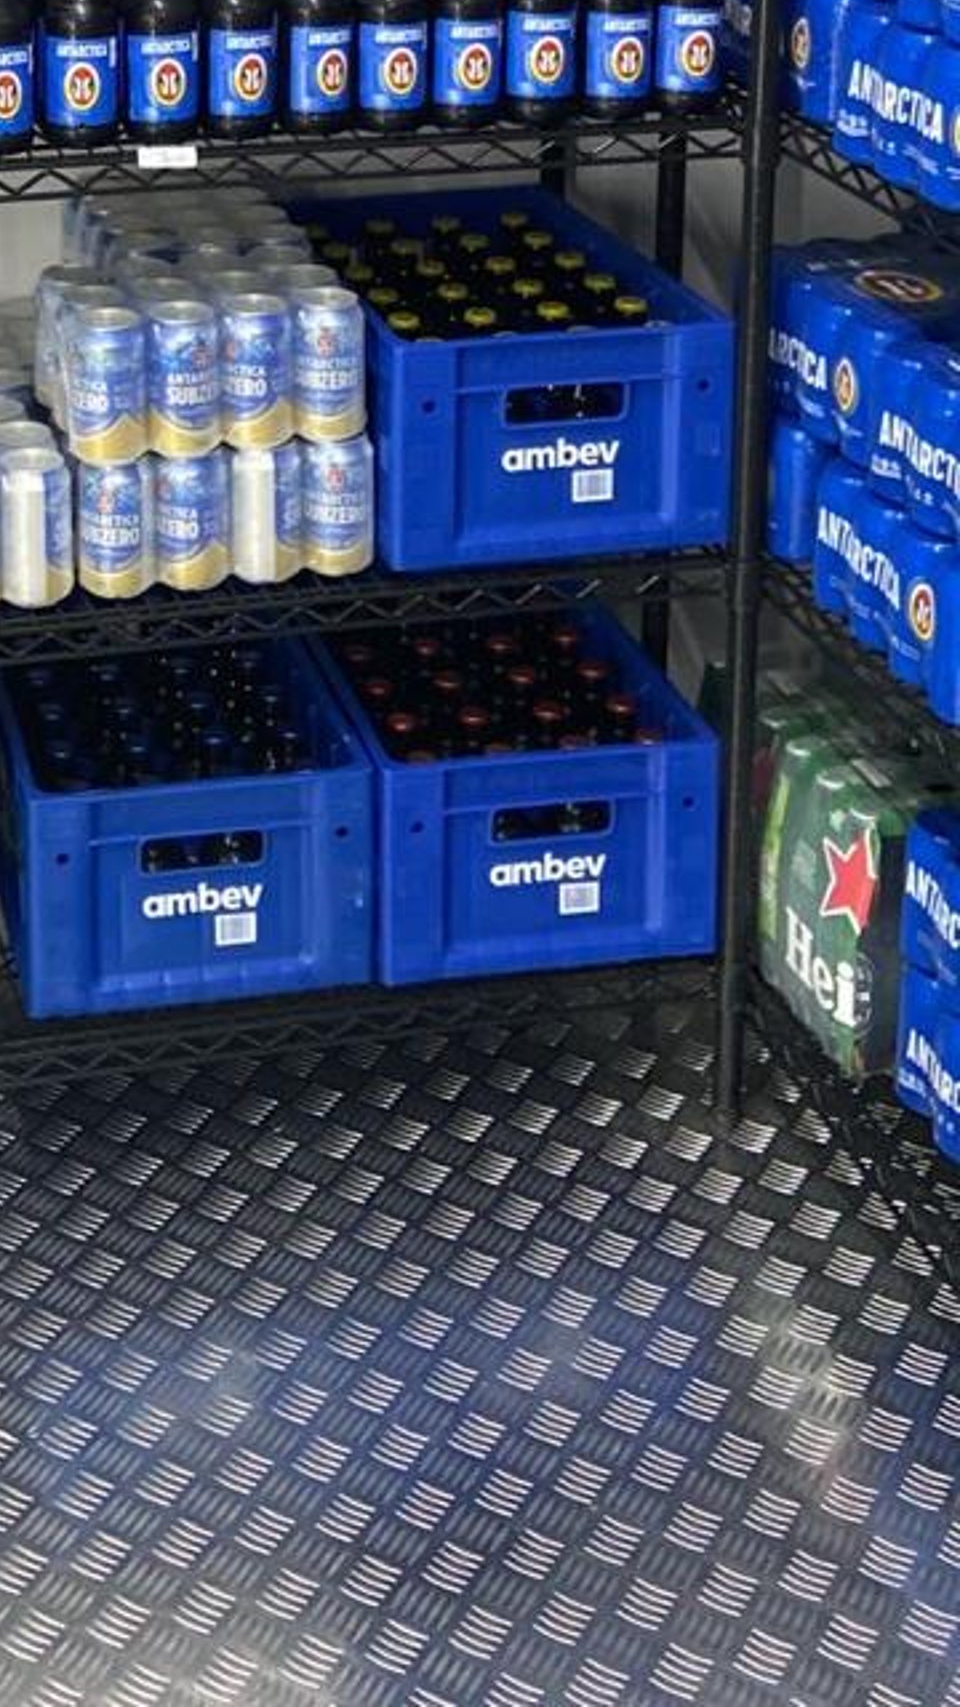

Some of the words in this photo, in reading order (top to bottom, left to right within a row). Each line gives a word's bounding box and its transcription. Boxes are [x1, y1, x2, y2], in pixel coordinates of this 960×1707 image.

[848, 59, 945, 145] ANTARCTICA
[501, 437, 620, 473] ambev
[817, 506, 900, 611] ANTARCTICA
[142, 881, 263, 919] ambev
[489, 851, 606, 887] ambev
[784, 906, 858, 1027] Hei
